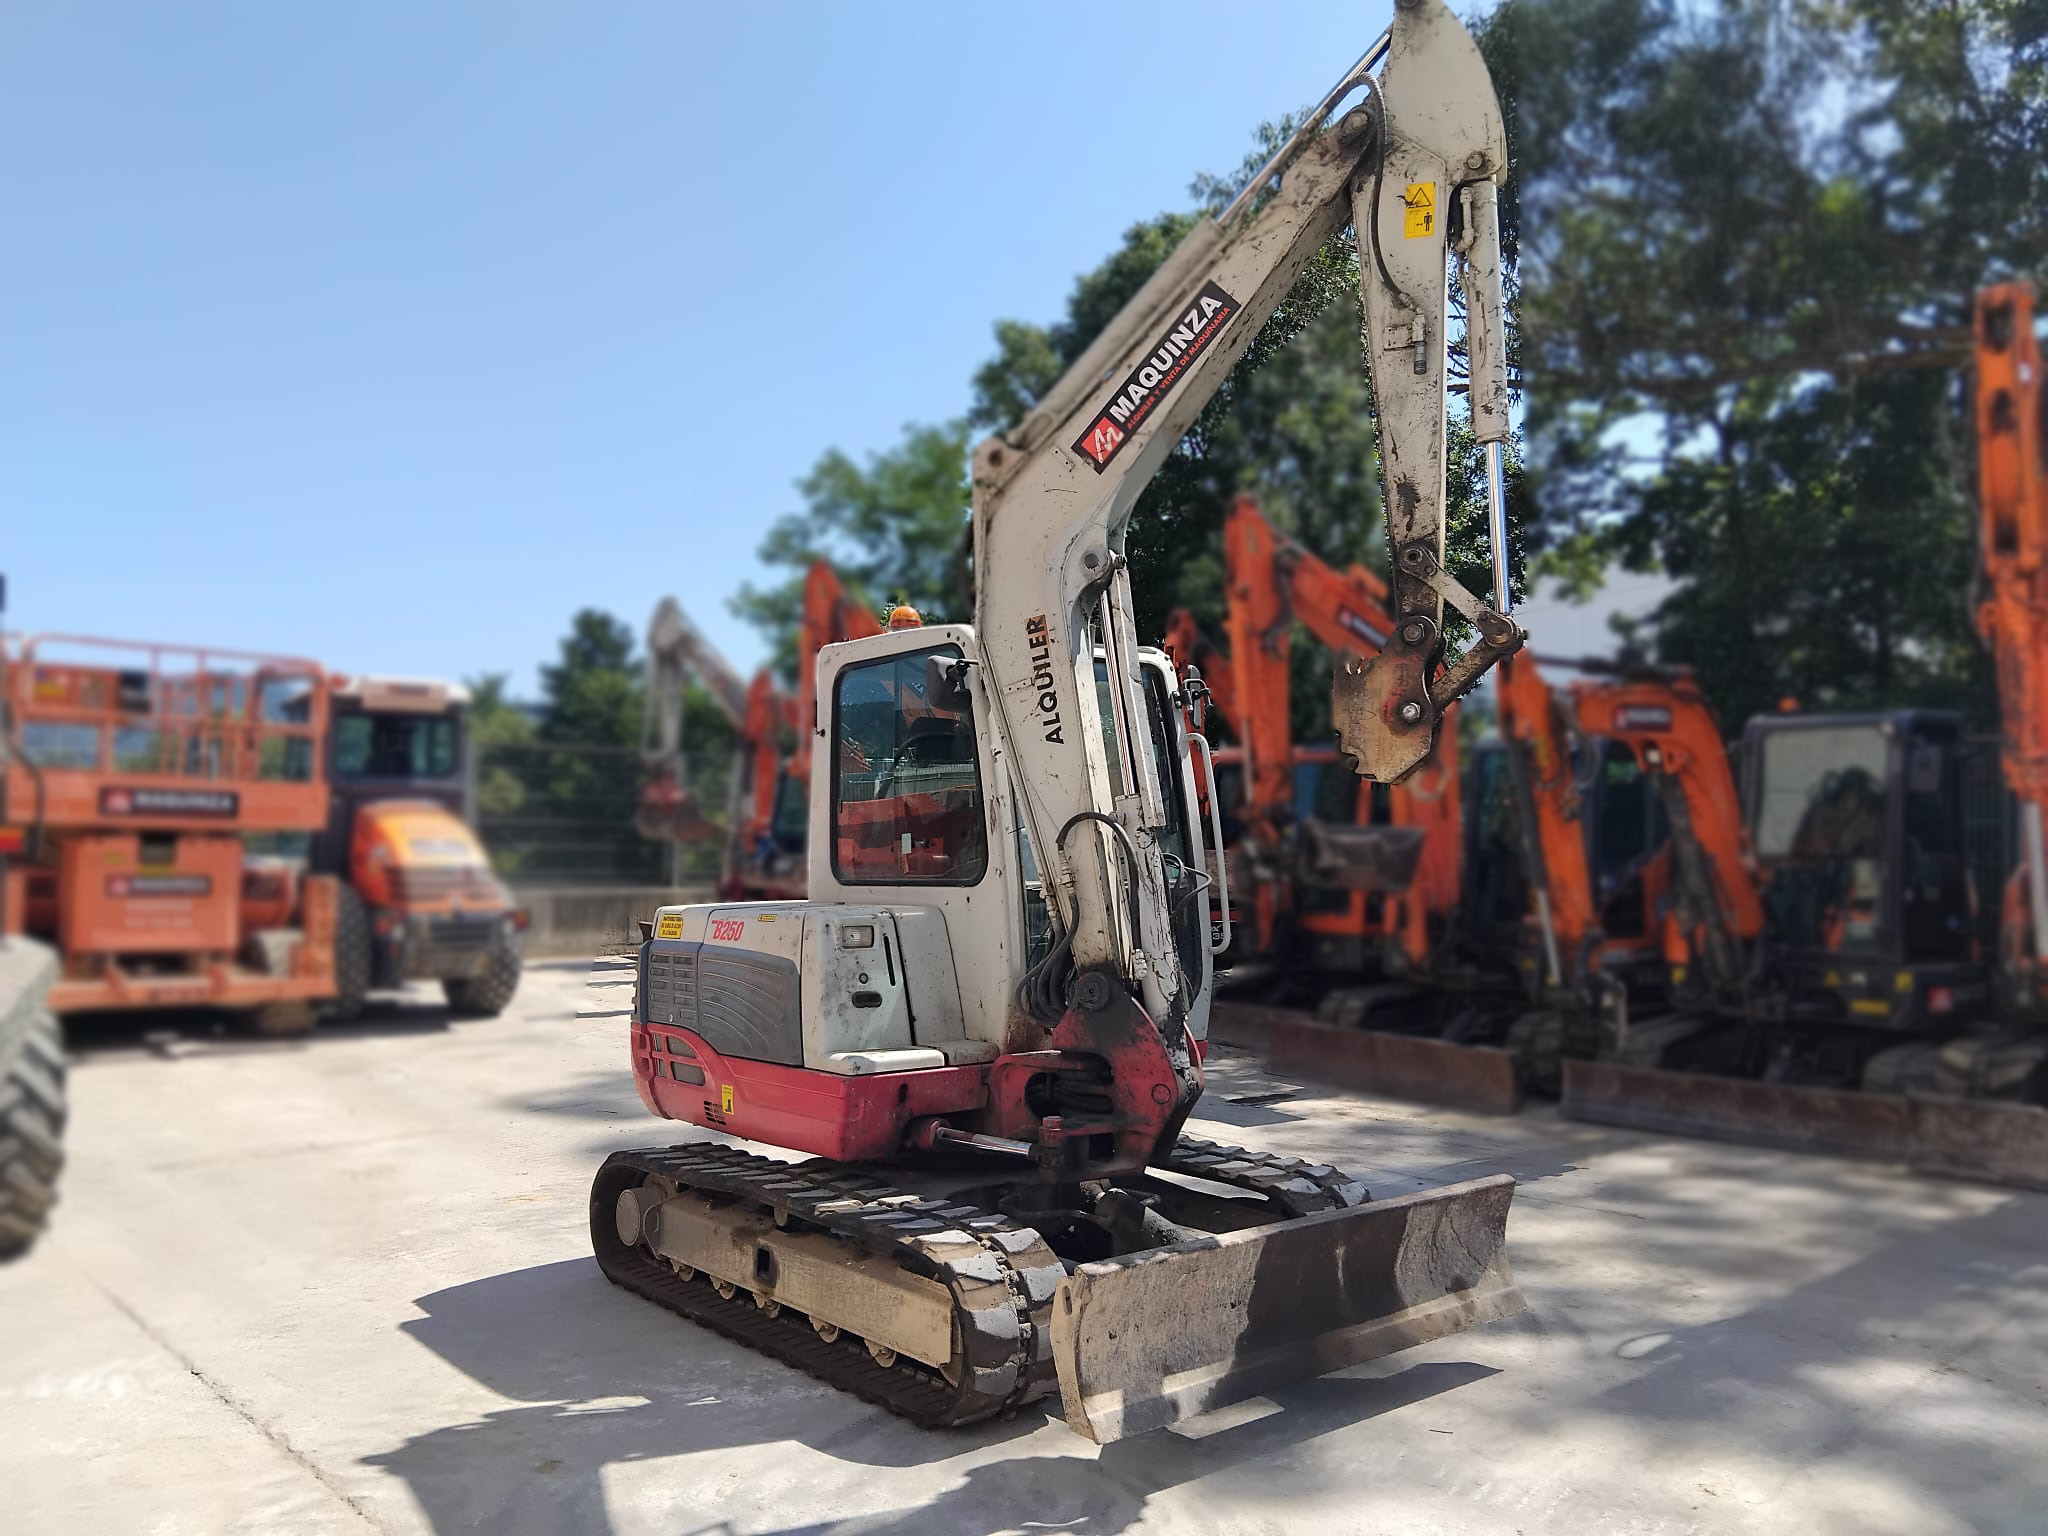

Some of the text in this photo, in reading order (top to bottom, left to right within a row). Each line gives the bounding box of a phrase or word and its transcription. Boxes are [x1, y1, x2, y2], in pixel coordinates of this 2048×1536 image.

[1108, 295, 1223, 424] MAQUINZA
[1127, 396, 1156, 430] ALQUILER
[1159, 366, 1181, 389] VENTA
[1179, 354, 1190, 366] DE
[1188, 307, 1231, 356] MAQUINARIA
[1025, 617, 1065, 745] ALQUILER
